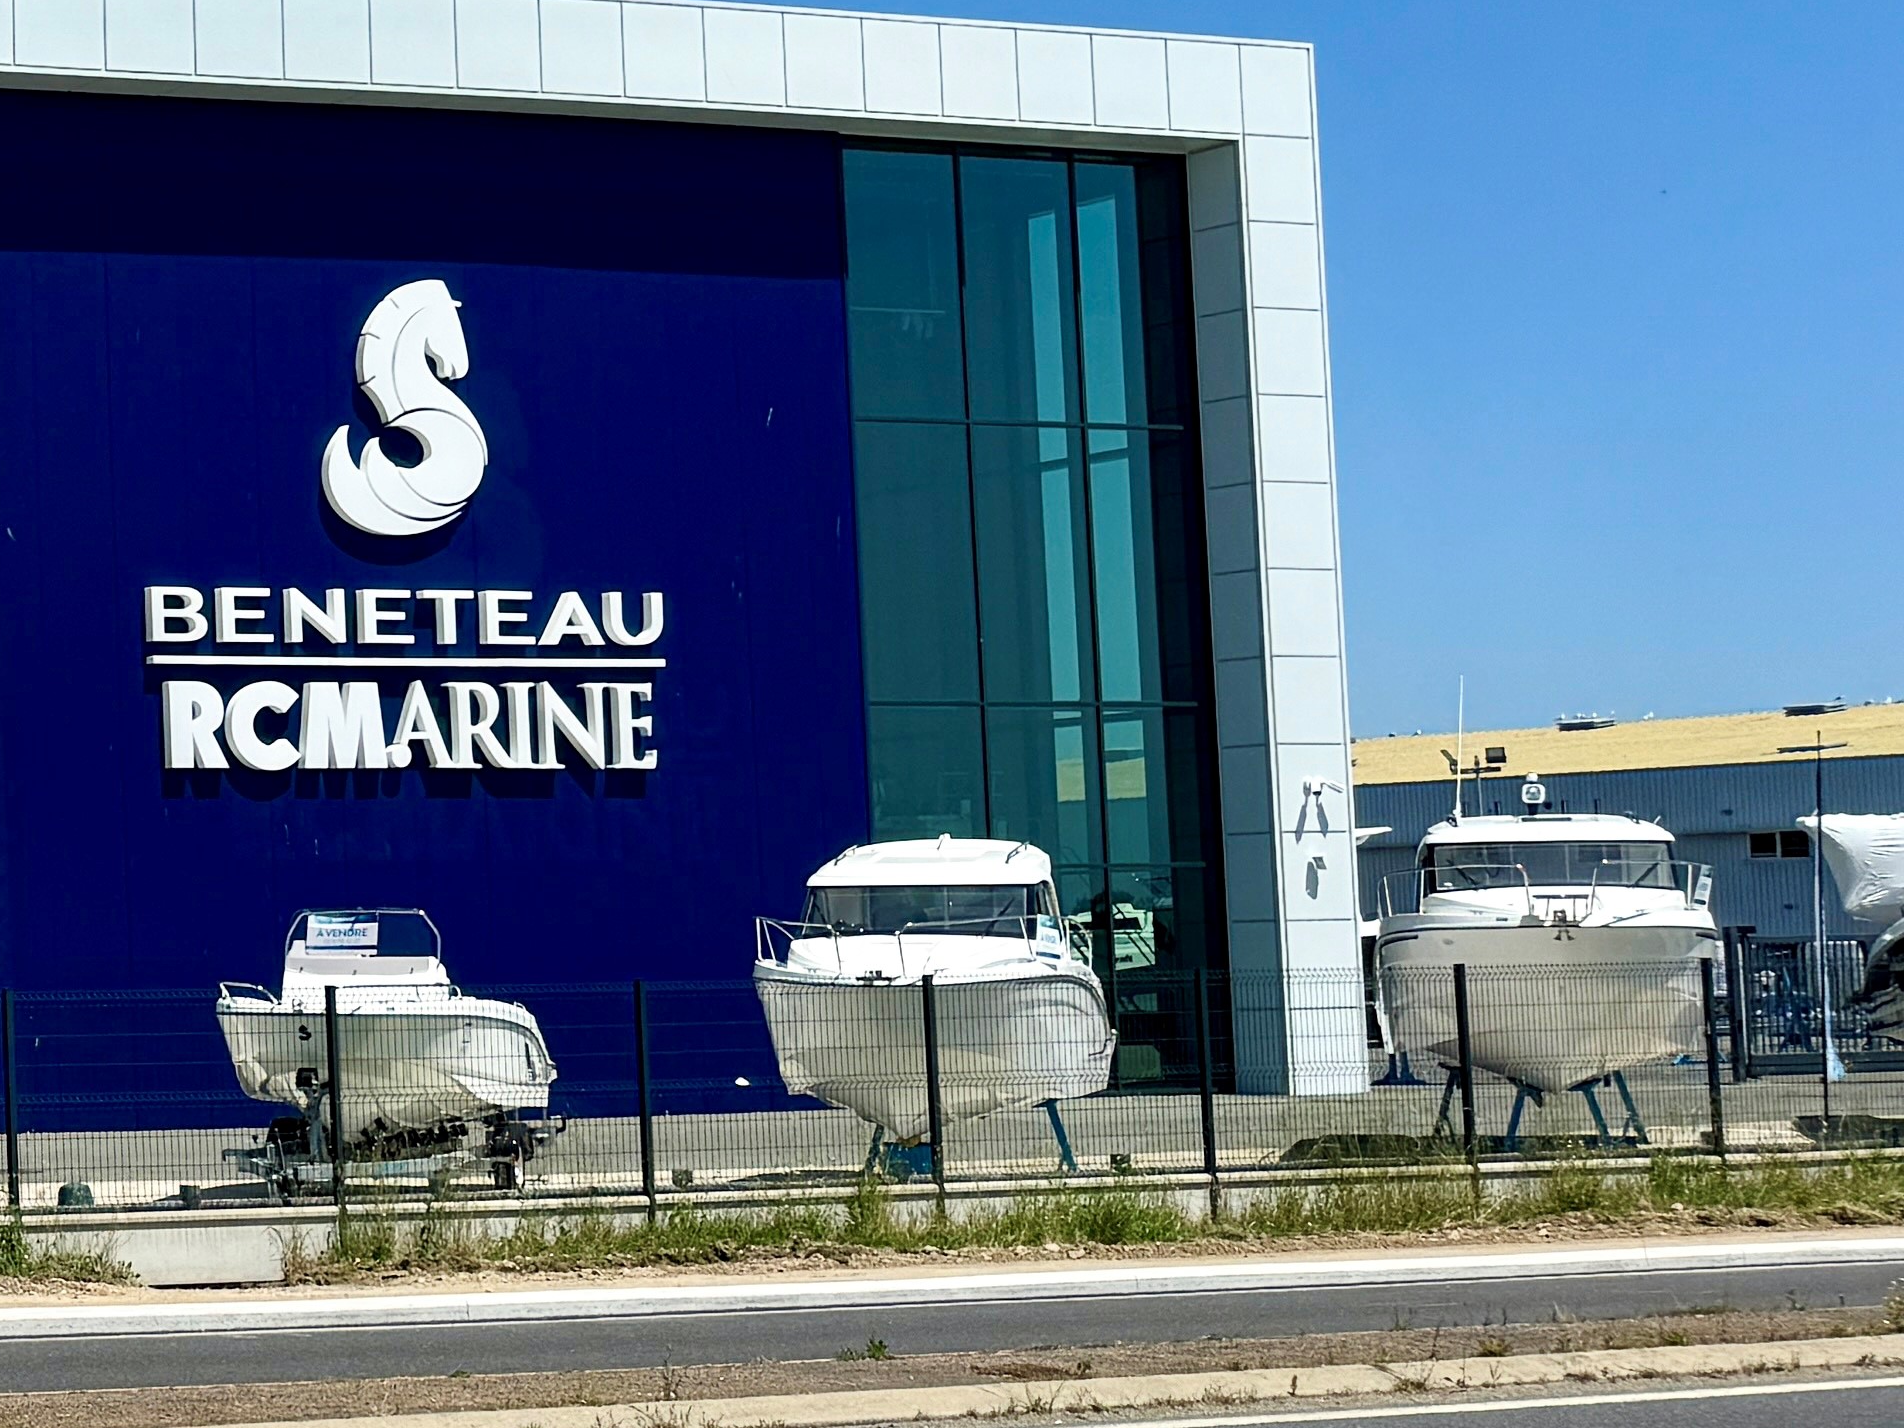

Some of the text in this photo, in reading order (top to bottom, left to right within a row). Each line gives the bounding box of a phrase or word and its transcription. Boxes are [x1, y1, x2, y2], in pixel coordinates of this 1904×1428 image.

[144, 585, 665, 647] BENETEAU
[162, 679, 658, 771] RCMARINE
[325, 927, 369, 938] VENDRE
